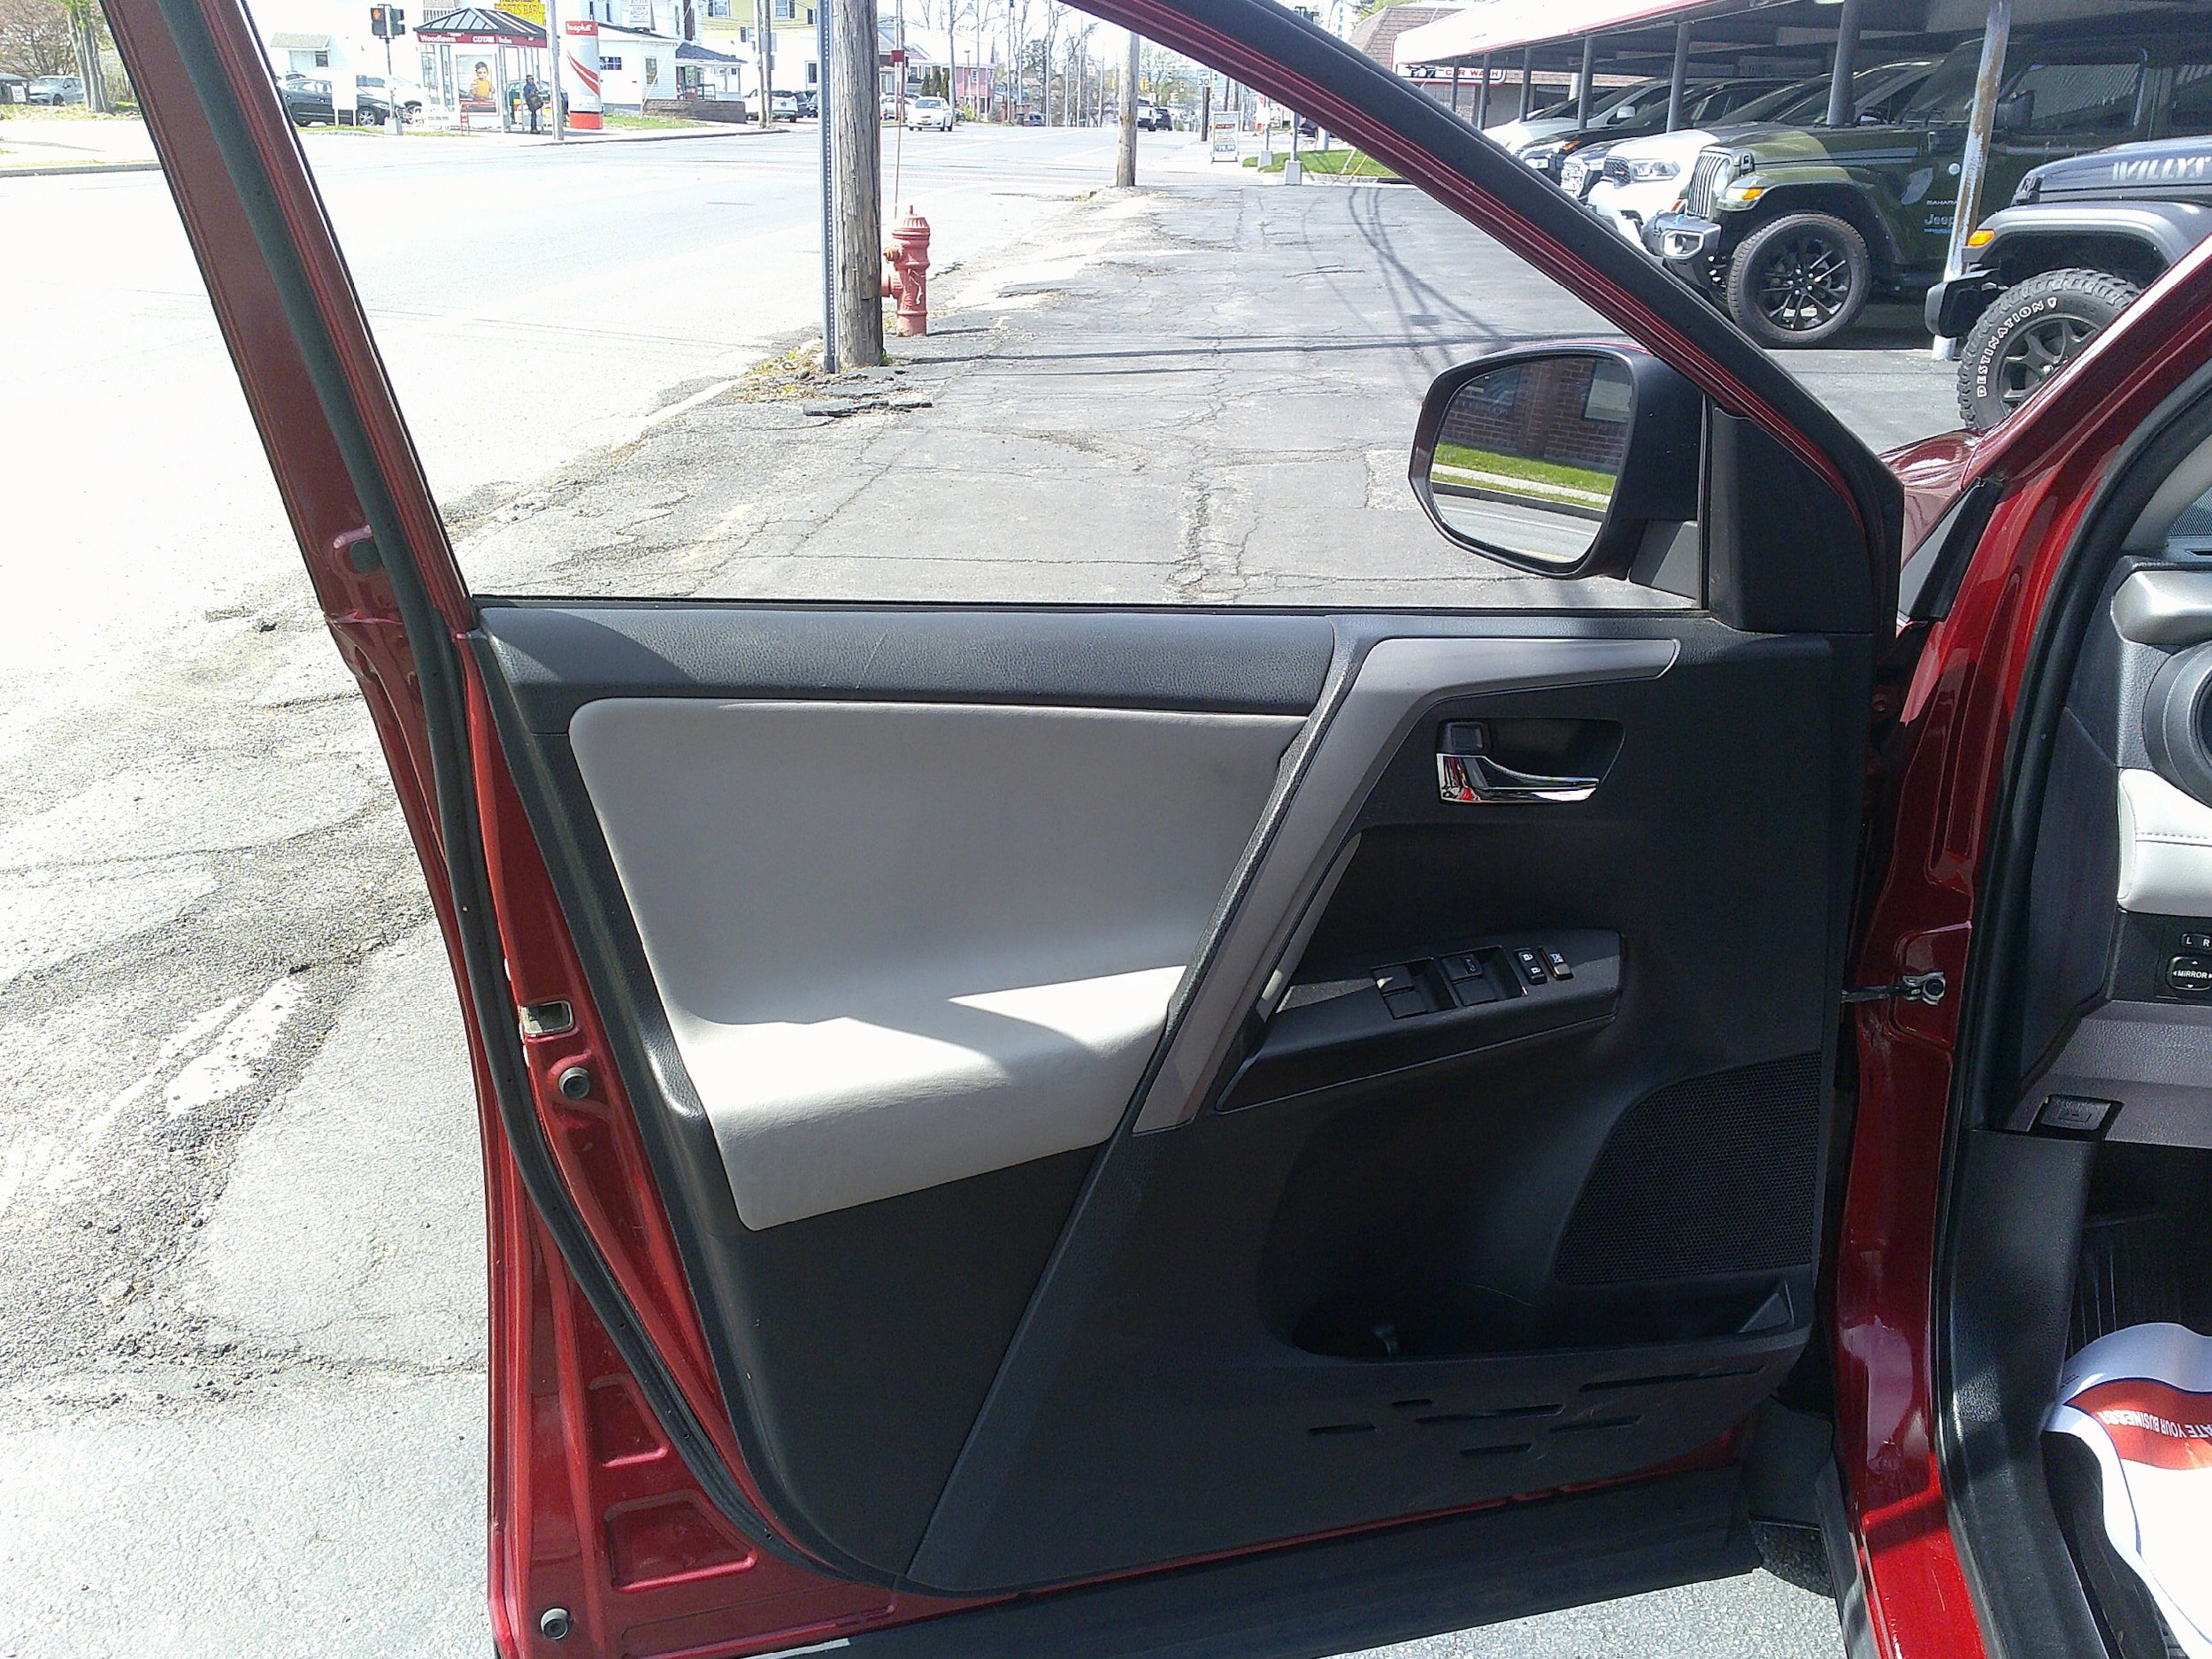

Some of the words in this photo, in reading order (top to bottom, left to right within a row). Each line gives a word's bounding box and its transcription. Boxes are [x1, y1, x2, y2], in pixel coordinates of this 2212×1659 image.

[1924, 213, 1955, 227] Jeep
[1977, 299, 2045, 397] DESTINATION
[2185, 936, 2193, 945] L
[2202, 939, 2210, 948] R
[2177, 970, 2208, 979] MIRROR
[2159, 1417, 2187, 1438] YOUR
